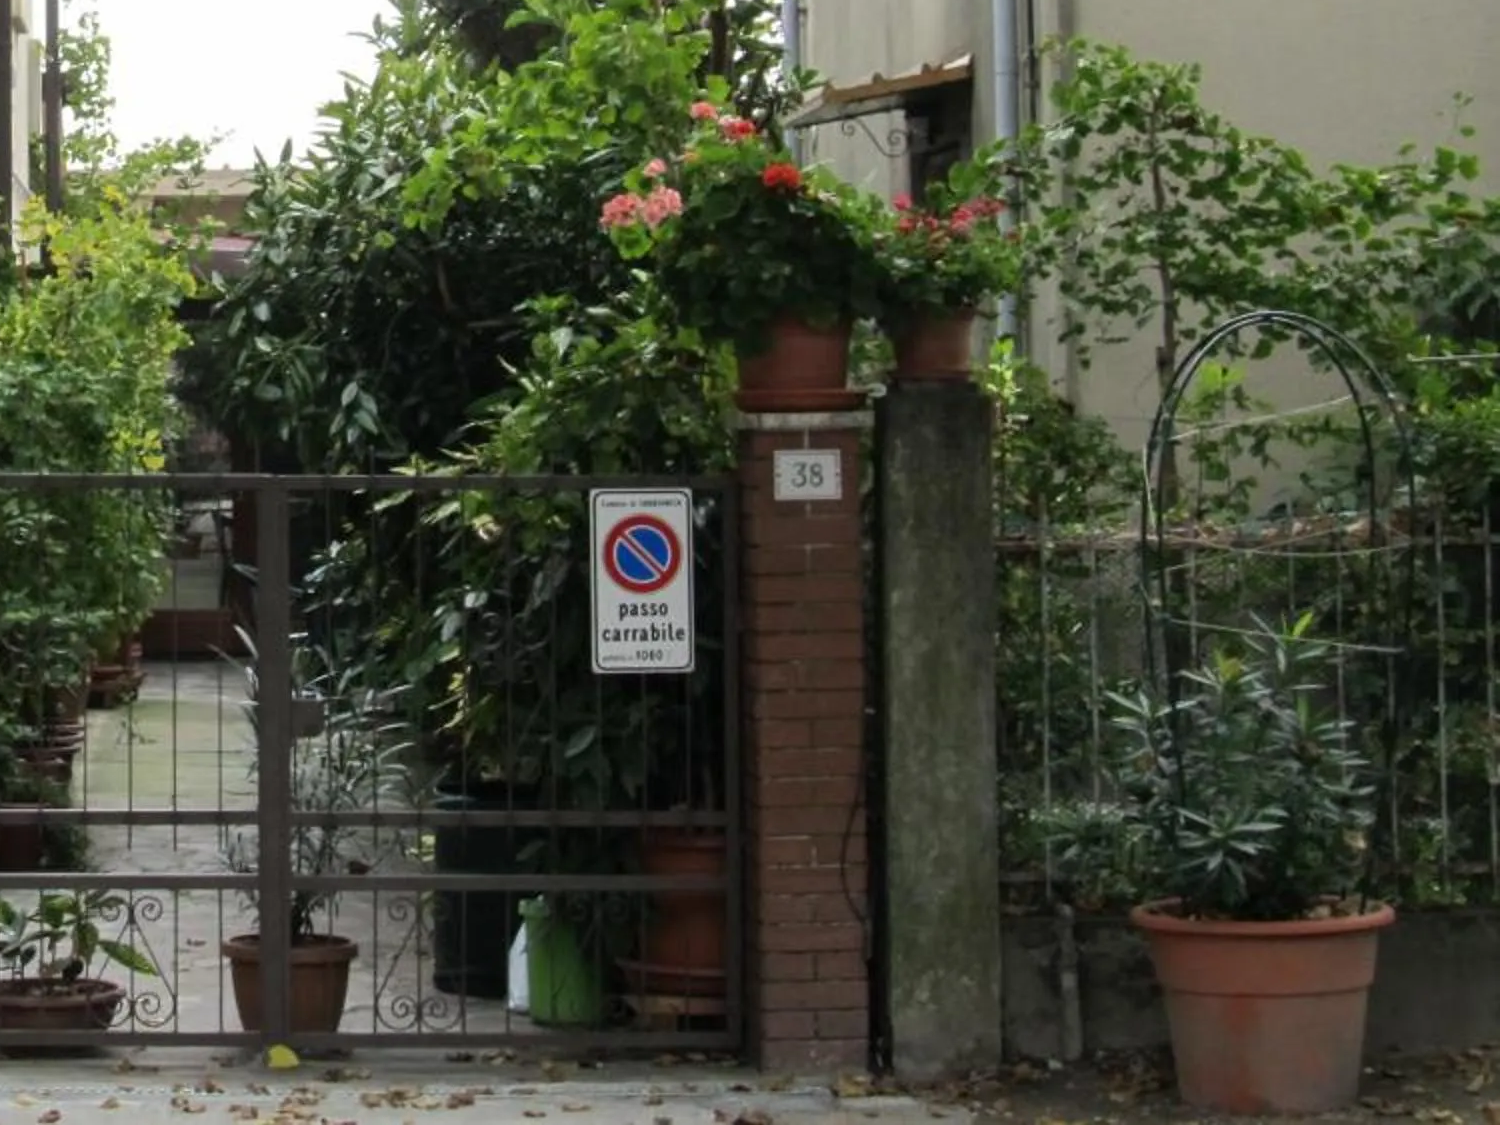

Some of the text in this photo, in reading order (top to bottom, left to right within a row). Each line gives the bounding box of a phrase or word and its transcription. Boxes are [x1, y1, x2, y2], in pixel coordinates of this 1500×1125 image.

[791, 462, 823, 488] 38
[618, 602, 668, 620] passo
[602, 623, 685, 642] carrabile
